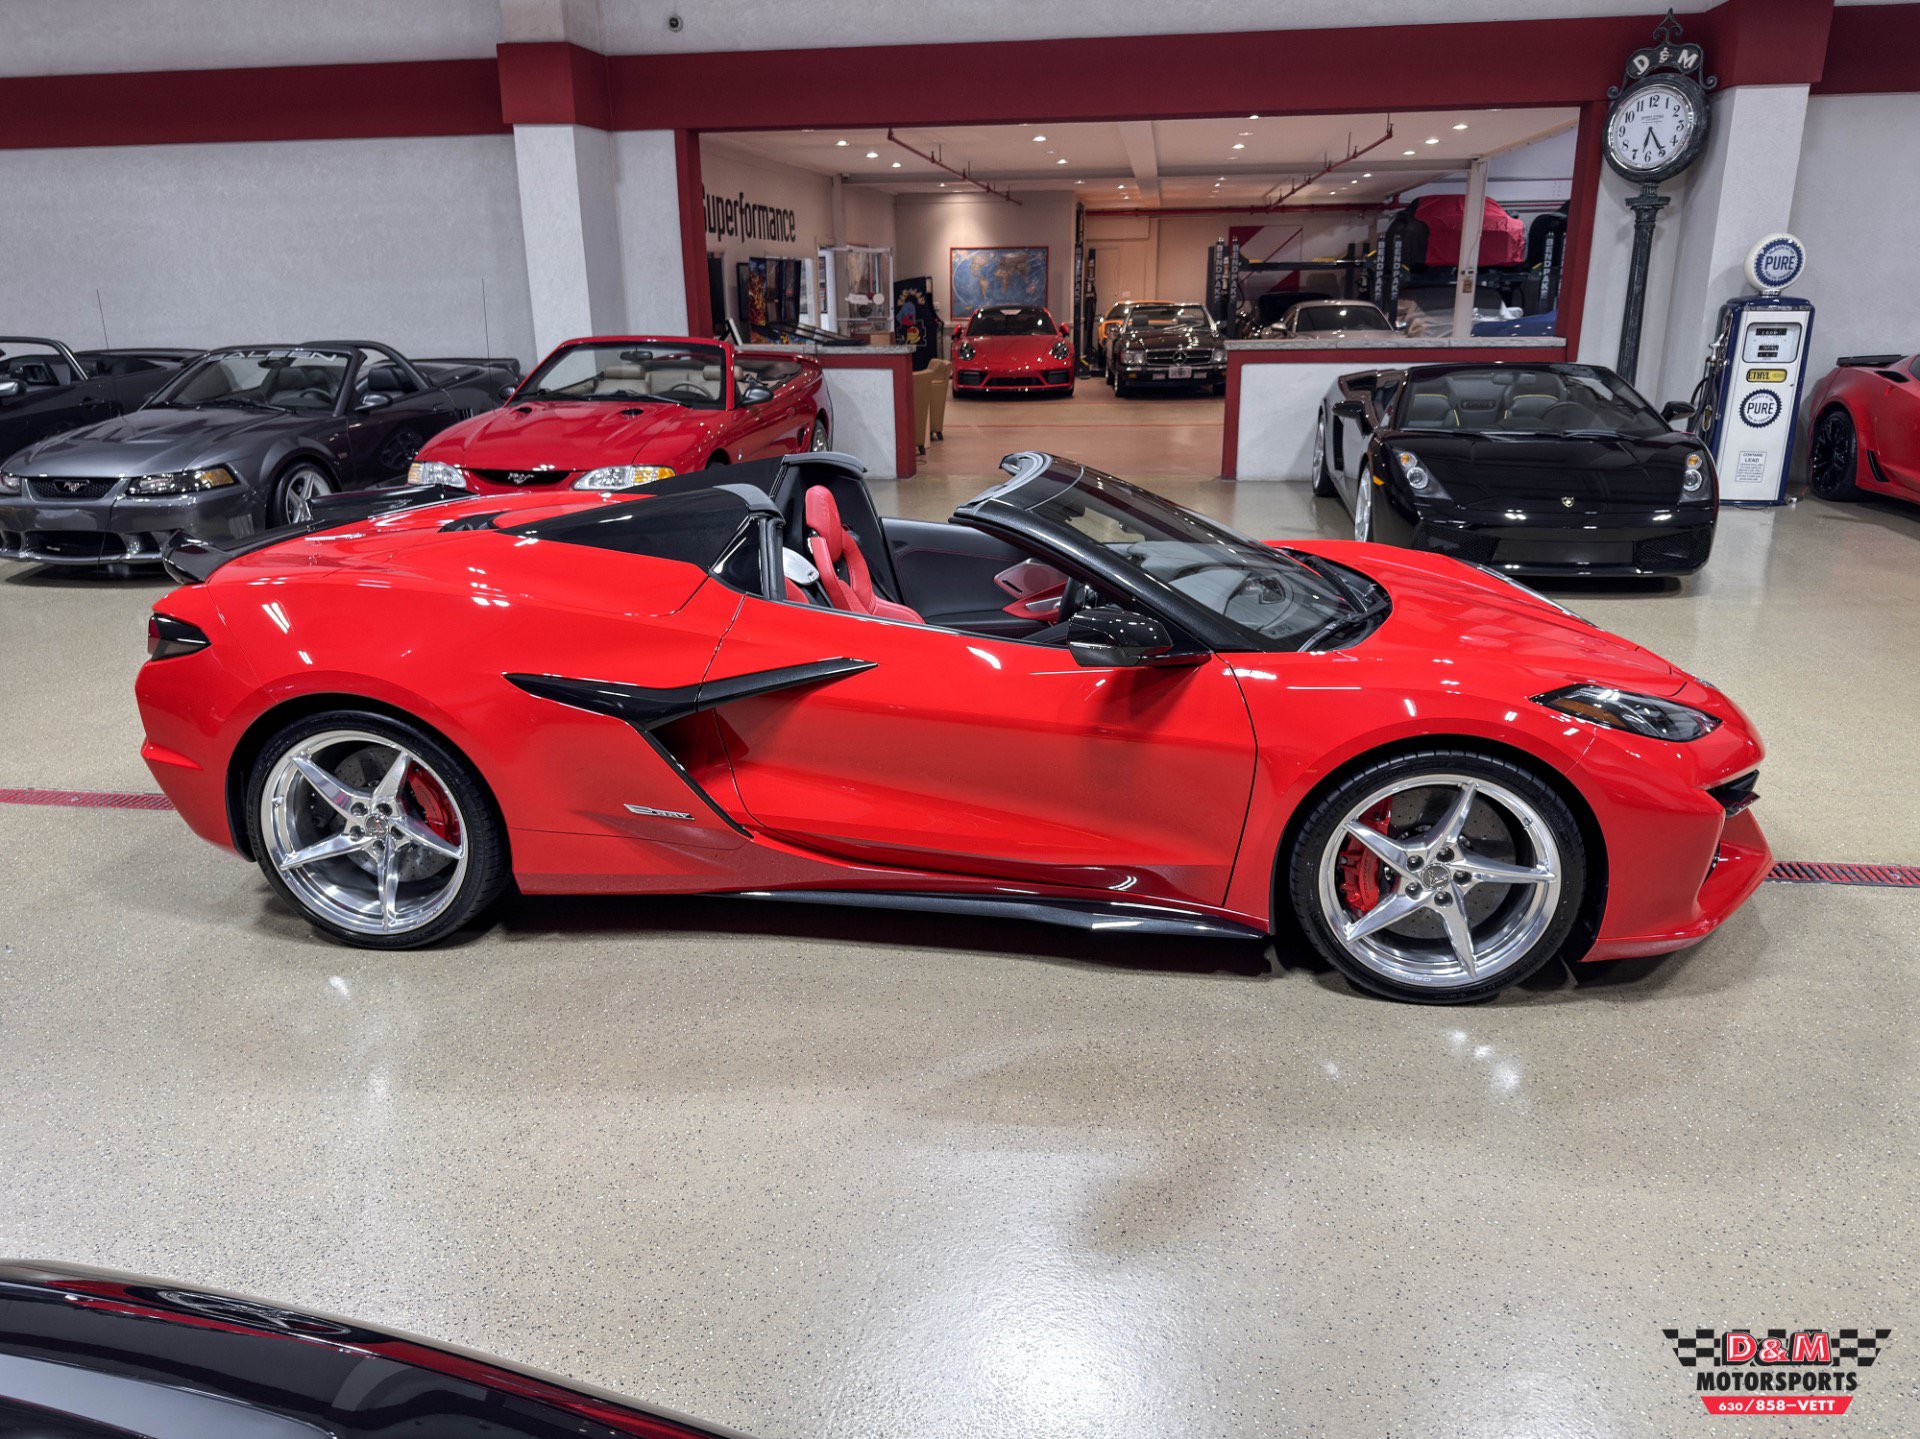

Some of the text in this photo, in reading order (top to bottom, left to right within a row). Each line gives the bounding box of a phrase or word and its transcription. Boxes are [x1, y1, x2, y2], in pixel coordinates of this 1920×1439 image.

[1636, 100, 1644, 112] 11
[1649, 95, 1660, 108] 12
[1625, 111, 1635, 123] 10
[1672, 105, 1680, 117] 2
[1619, 126, 1626, 137] 9
[1676, 120, 1684, 132] 3
[1622, 140, 1629, 151] 8
[1670, 135, 1679, 146] 4
[1632, 149, 1639, 160] 7
[1644, 151, 1652, 162] 6
[1764, 255, 1796, 271] PURE
[1746, 402, 1775, 415] PURE
